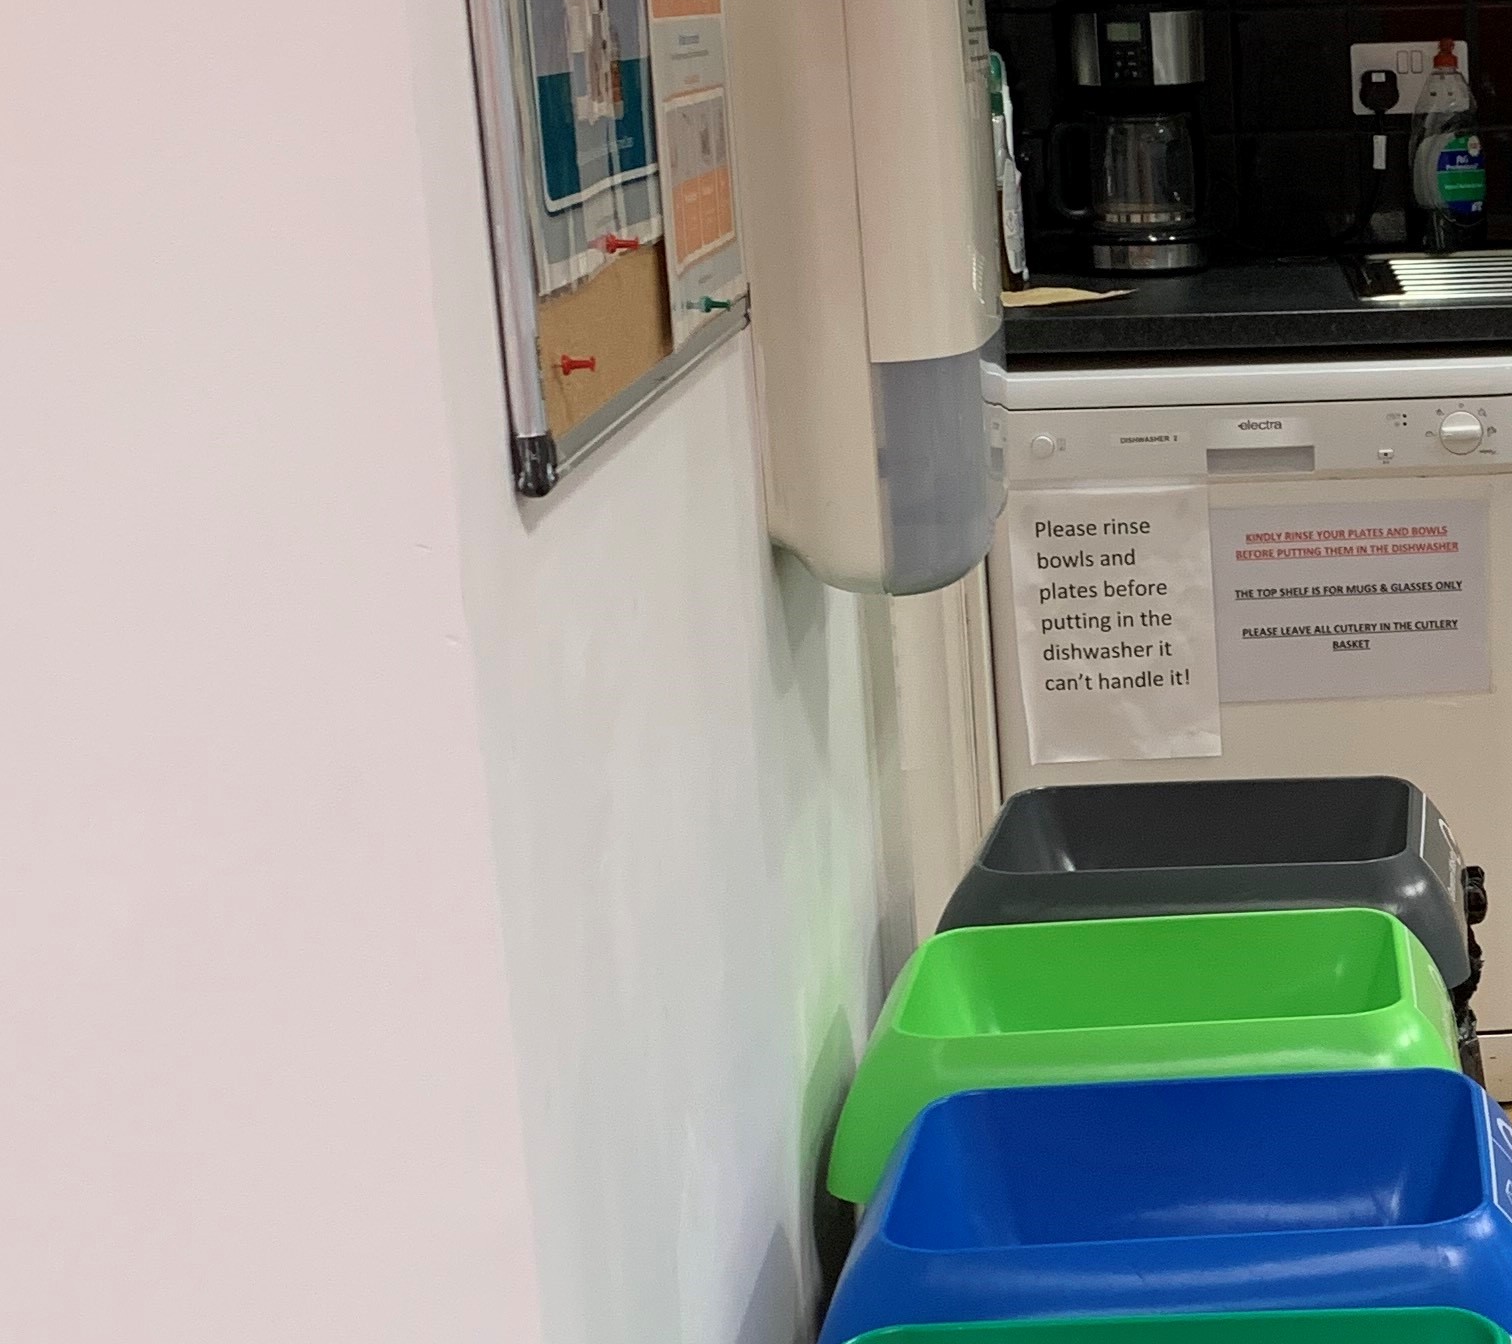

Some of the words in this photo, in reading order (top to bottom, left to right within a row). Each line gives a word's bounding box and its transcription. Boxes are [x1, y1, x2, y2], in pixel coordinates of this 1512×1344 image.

[1238, 419, 1282, 431] electra
[1119, 435, 1170, 444] DISHWASHER
[1035, 520, 1097, 538] Please
[1103, 519, 1151, 535] rinse
[1246, 532, 1282, 543] KINDLY
[1285, 531, 1313, 541] RINSE
[1317, 530, 1345, 540] YOUR
[1348, 528, 1383, 538] PLATES
[1386, 527, 1409, 536] AND
[1412, 525, 1448, 535] BOWLS
[1037, 550, 1094, 569] bowls
[1100, 548, 1136, 566] and
[1235, 549, 1274, 559] BEFORE
[1277, 547, 1321, 557] PUTTING
[1324, 546, 1354, 556] THEM
[1357, 545, 1367, 554] IN
[1370, 544, 1389, 554] THE
[1392, 542, 1459, 552] DISHWASHER
[1039, 582, 1098, 604] plates
[1104, 579, 1168, 597] before
[1235, 589, 1254, 598] THE
[1257, 588, 1277, 598] TOP
[1280, 587, 1309, 596] SHELF
[1312, 586, 1320, 595] IS
[1323, 585, 1343, 595] FOR
[1346, 584, 1377, 594] MUGS
[1380, 583, 1388, 592] &
[1391, 582, 1433, 592] GLASSES
[1435, 580, 1462, 590] ONLY
[1041, 612, 1111, 634] putting
[1117, 611, 1134, 627] in
[1140, 609, 1172, 627] the
[1242, 627, 1278, 637] PLEASE
[1281, 626, 1311, 635] LEAVE
[1314, 625, 1331, 634] ALL
[1333, 623, 1377, 633] CUTLERY
[1380, 622, 1390, 631] IN
[1393, 621, 1412, 630] THE
[1415, 619, 1458, 630] CUTLERY
[1043, 641, 1153, 661] dishwasher
[1159, 640, 1173, 656] it
[1332, 640, 1370, 649] BASKET
[1098, 670, 1164, 690] handle
[1170, 668, 1190, 686] it!
